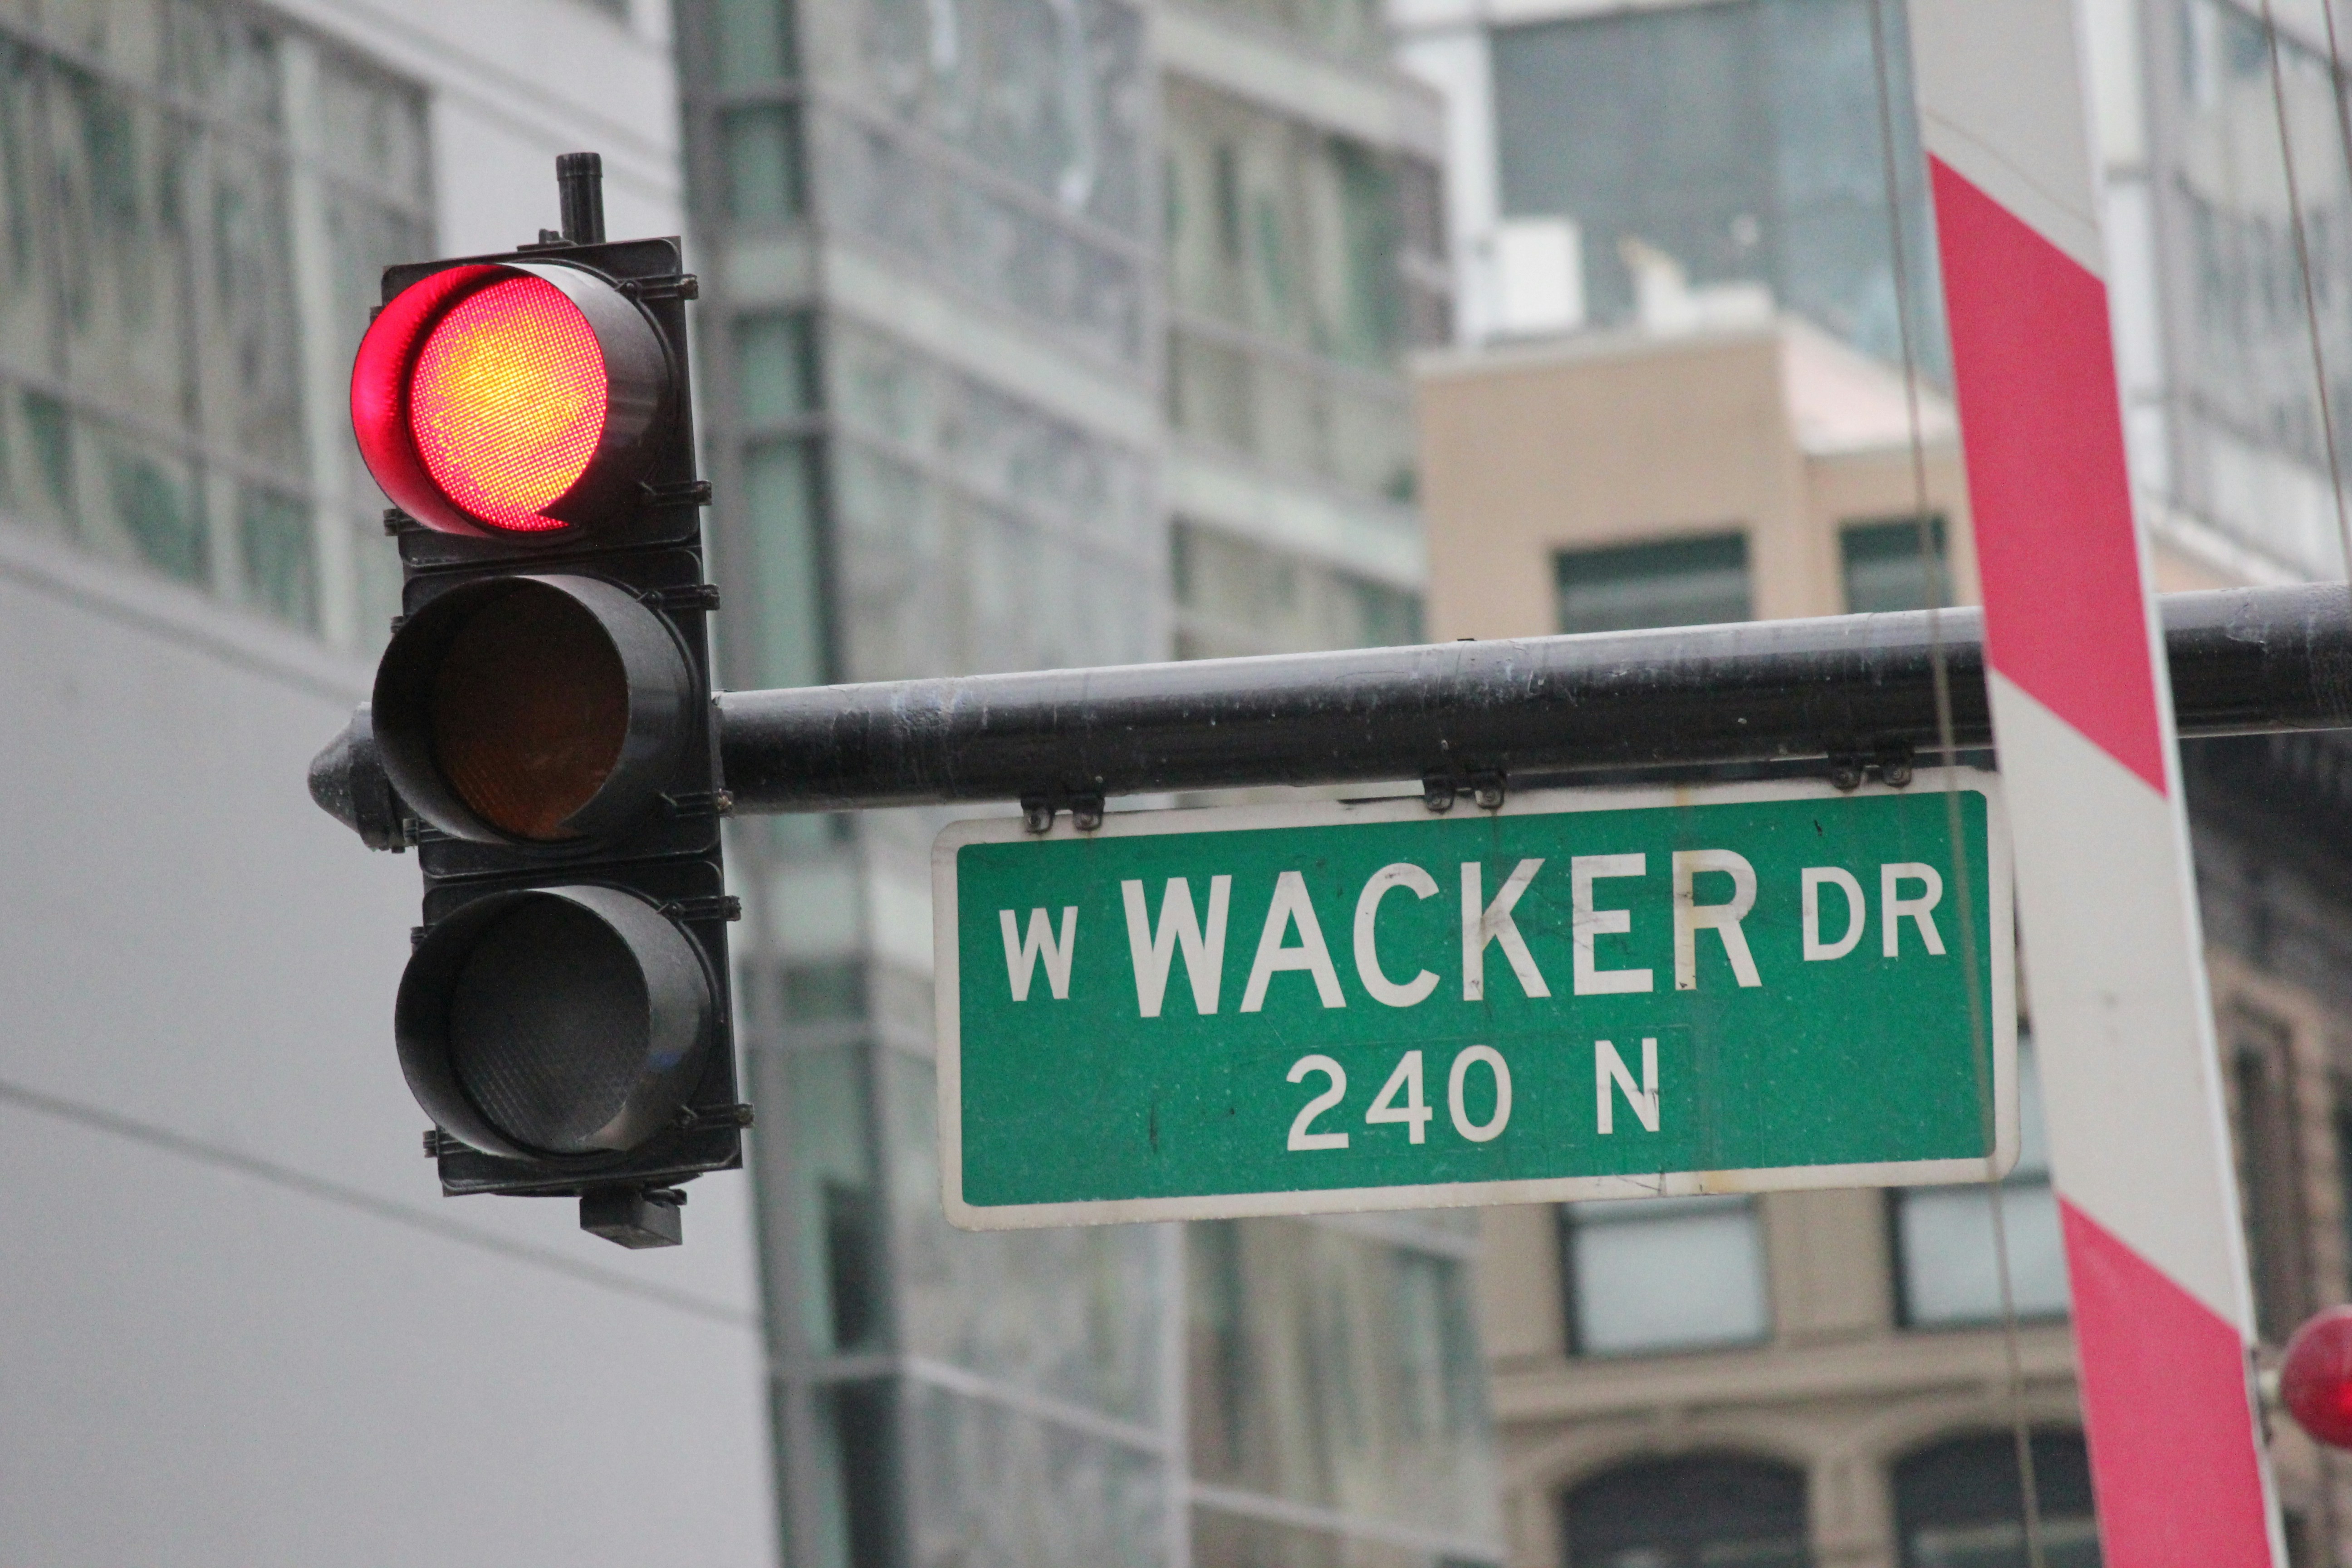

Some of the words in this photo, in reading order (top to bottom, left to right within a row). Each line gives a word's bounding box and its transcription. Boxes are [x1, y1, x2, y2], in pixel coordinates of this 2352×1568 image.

[1000, 906, 1078, 1002] W
[1121, 849, 1763, 1018] WACKER
[1802, 862, 1946, 961] DR
[1286, 1045, 1512, 1152] 240
[1595, 1038, 1660, 1135] N
